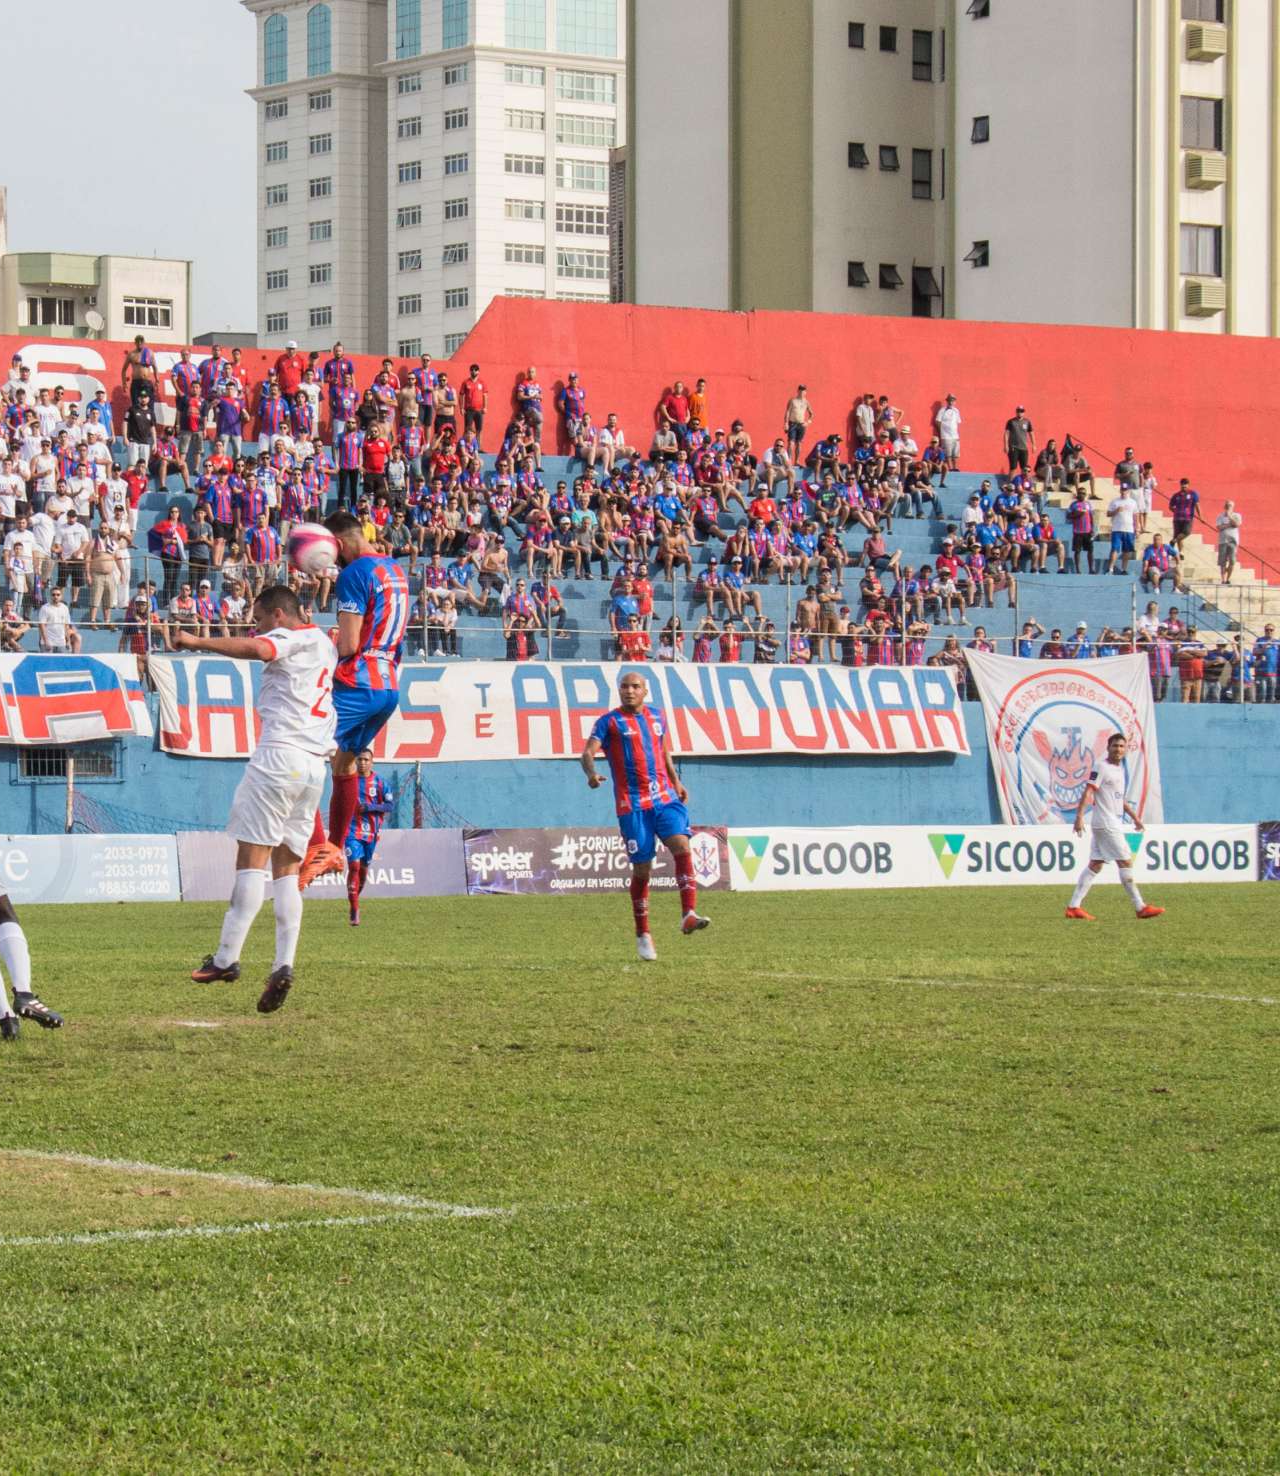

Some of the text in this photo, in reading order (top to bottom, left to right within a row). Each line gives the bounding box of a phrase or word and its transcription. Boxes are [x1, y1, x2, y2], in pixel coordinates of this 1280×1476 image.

[379, 592, 407, 646] 11
[161, 660, 447, 758] JAS
[311, 667, 330, 718] 2
[512, 665, 967, 755] ABANDONAR
[471, 846, 533, 880] spieler
[578, 853, 667, 872] OFICL
[772, 842, 894, 876] SICOOB
[966, 840, 1076, 873] SICOOB
[1146, 839, 1250, 871] SICOOB
[506, 870, 533, 880] SPORTS
[550, 878, 586, 889] ORGULHO
[587, 878, 598, 888] EM
[598, 878, 624, 888] VESTIR
